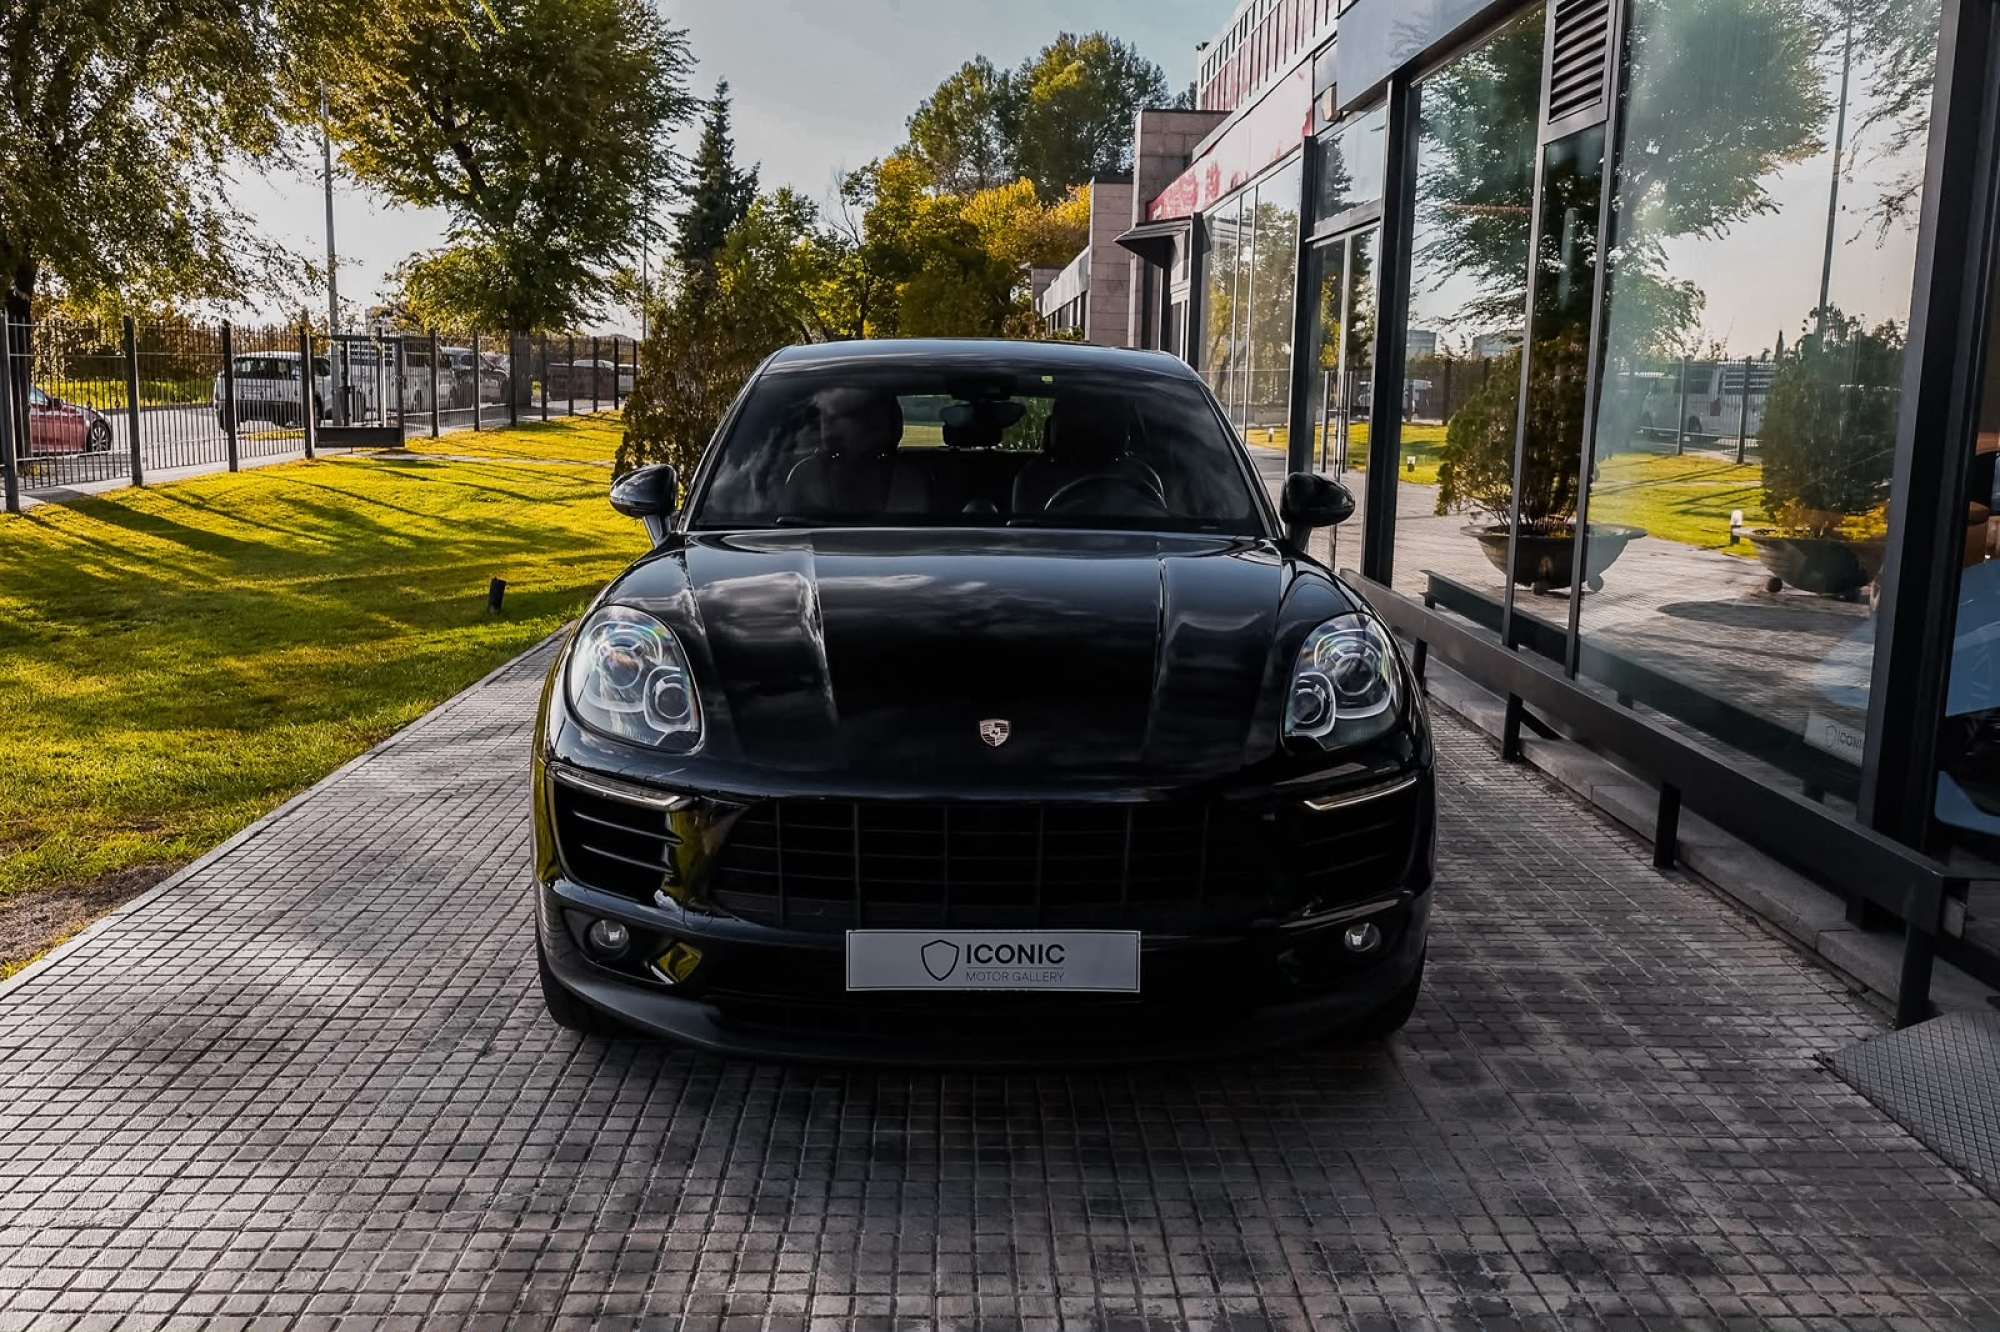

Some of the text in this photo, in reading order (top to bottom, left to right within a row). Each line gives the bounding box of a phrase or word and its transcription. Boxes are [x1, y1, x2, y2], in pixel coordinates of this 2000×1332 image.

[1837, 730, 1862, 750] ICONI
[966, 944, 1065, 964] ICONIC
[965, 971, 1065, 982] MOTOR GALLERY
